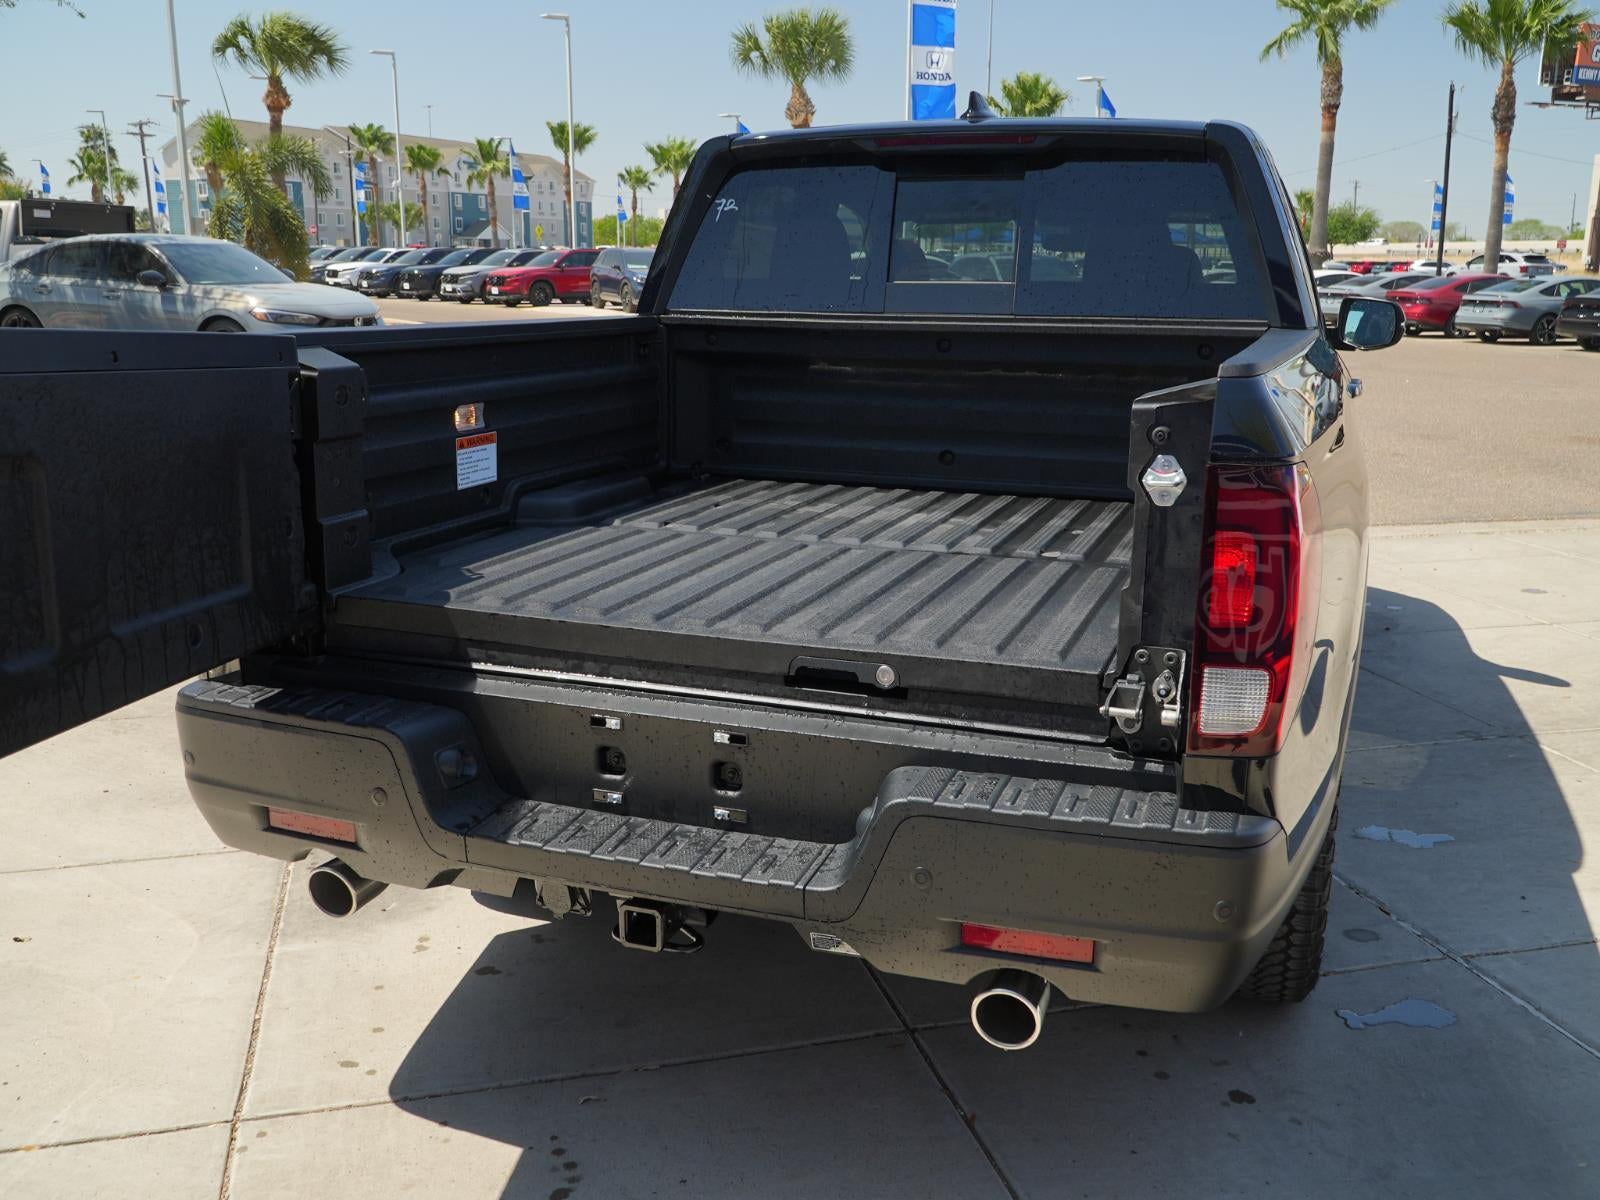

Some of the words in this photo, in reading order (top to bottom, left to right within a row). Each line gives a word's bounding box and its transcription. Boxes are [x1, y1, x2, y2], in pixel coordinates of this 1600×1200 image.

[916, 71, 952, 81] HONDA
[715, 198, 738, 223] 72
[467, 433, 495, 447] WARNING
